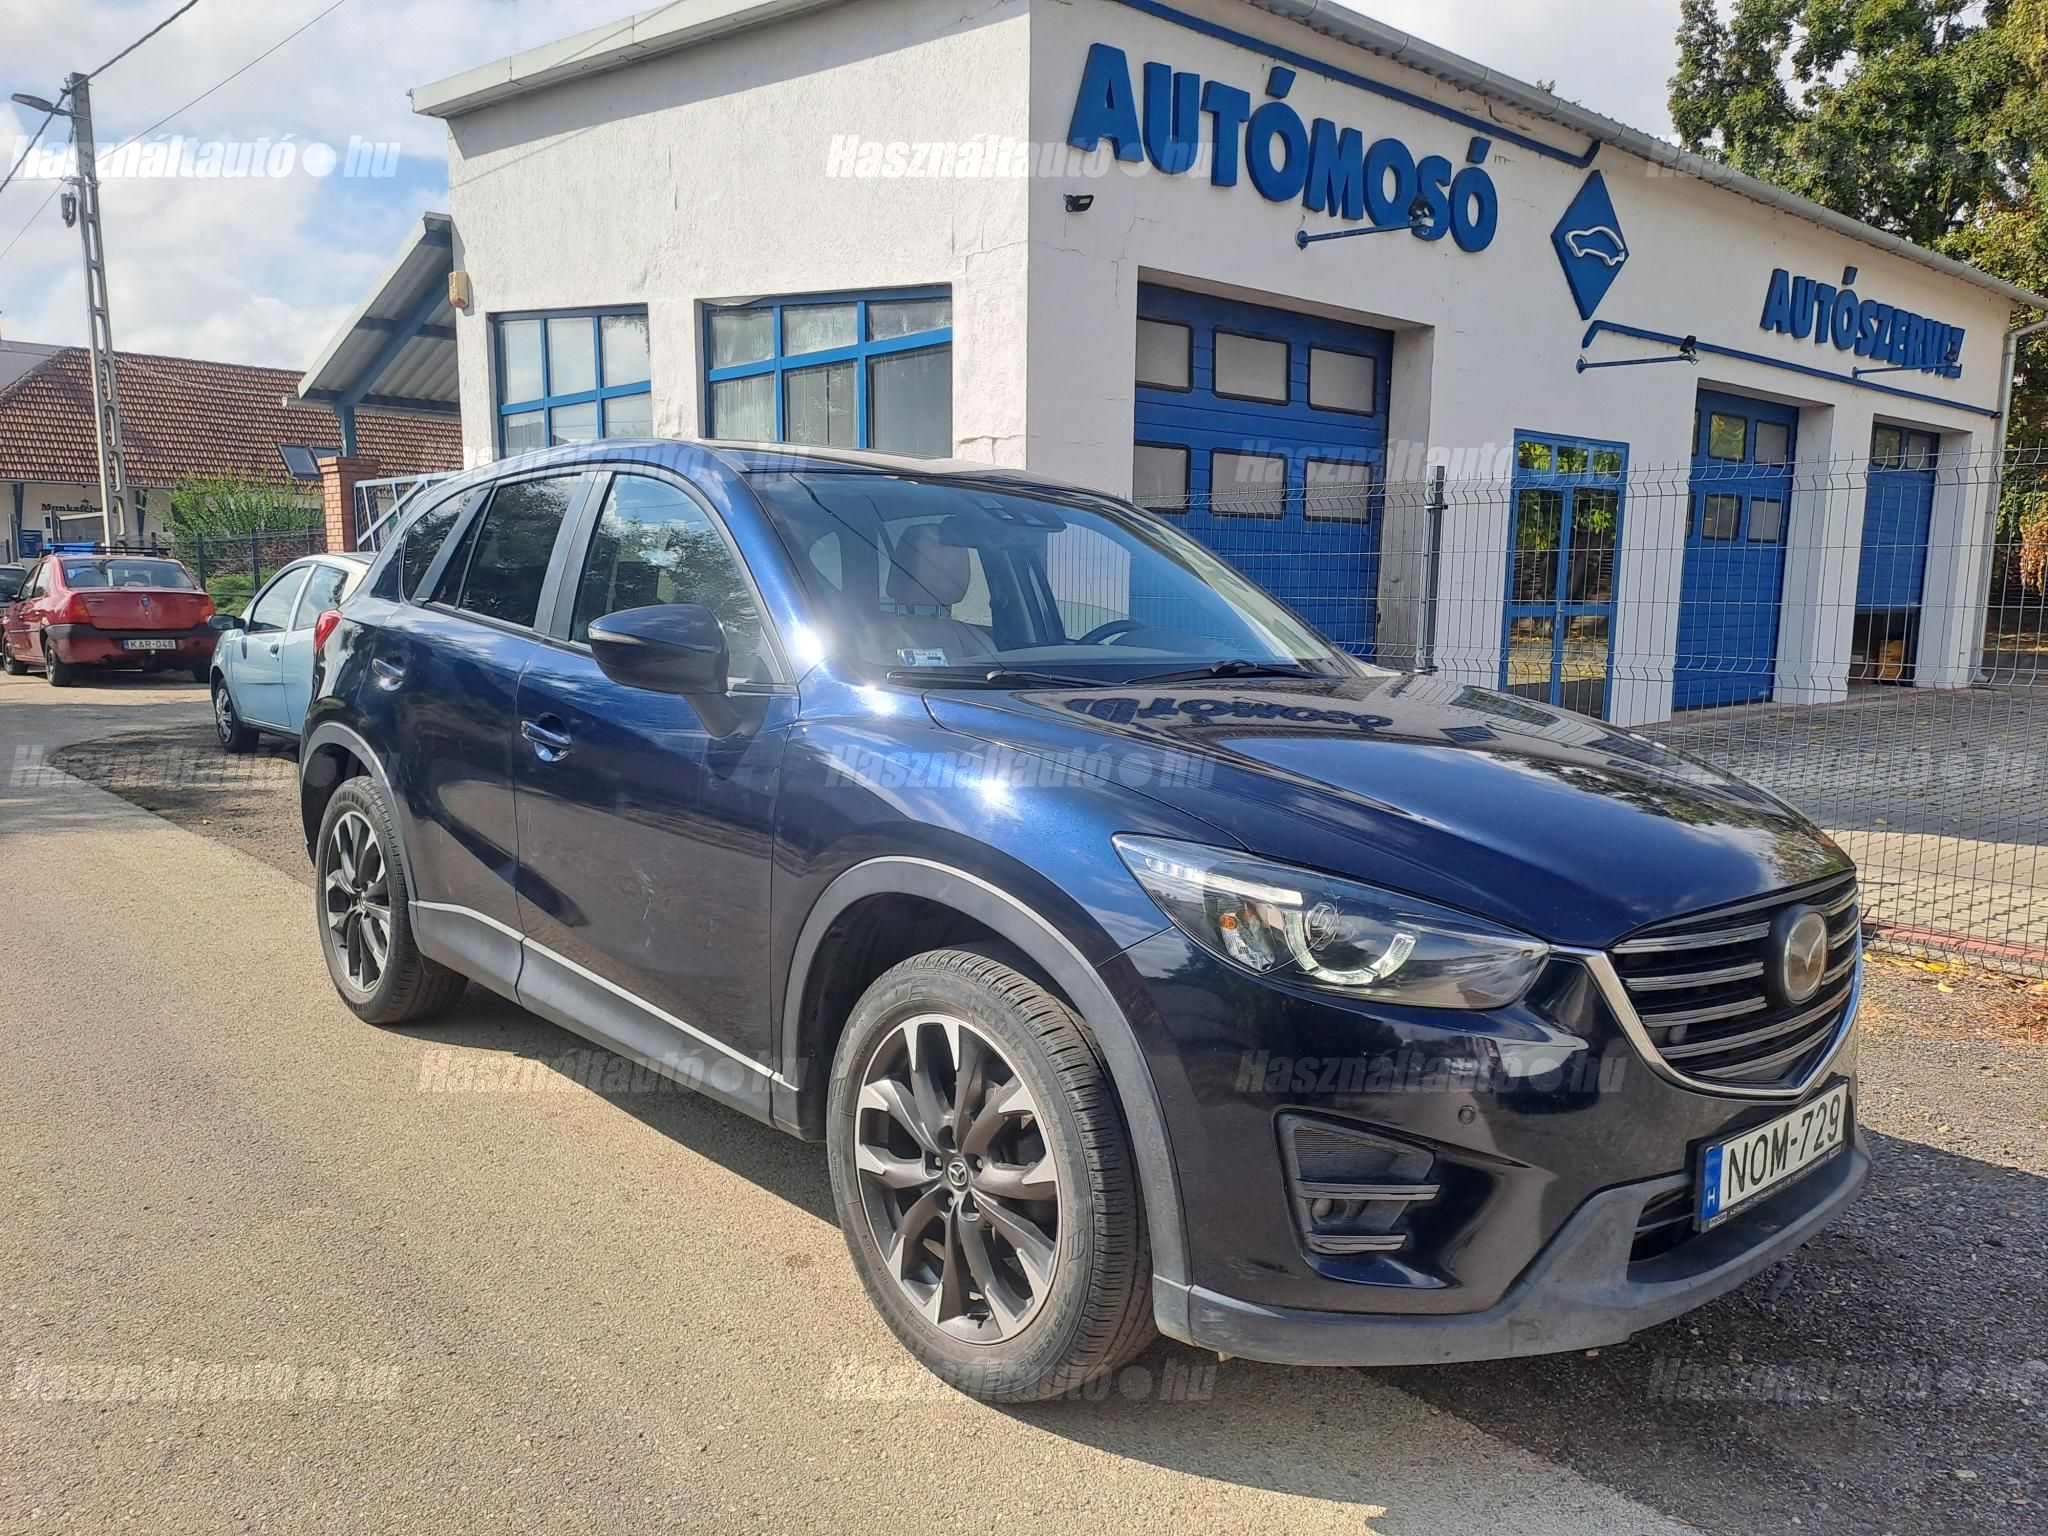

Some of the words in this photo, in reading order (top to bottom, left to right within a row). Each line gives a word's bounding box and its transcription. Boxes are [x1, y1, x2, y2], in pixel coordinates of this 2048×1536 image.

[1067, 42, 1498, 253] AUTÓMOSÓ
[1759, 266, 1966, 379] AUTÓSZERVIZ
[1707, 1187, 1716, 1207] H
[1727, 1093, 1841, 1201] NOM-729
